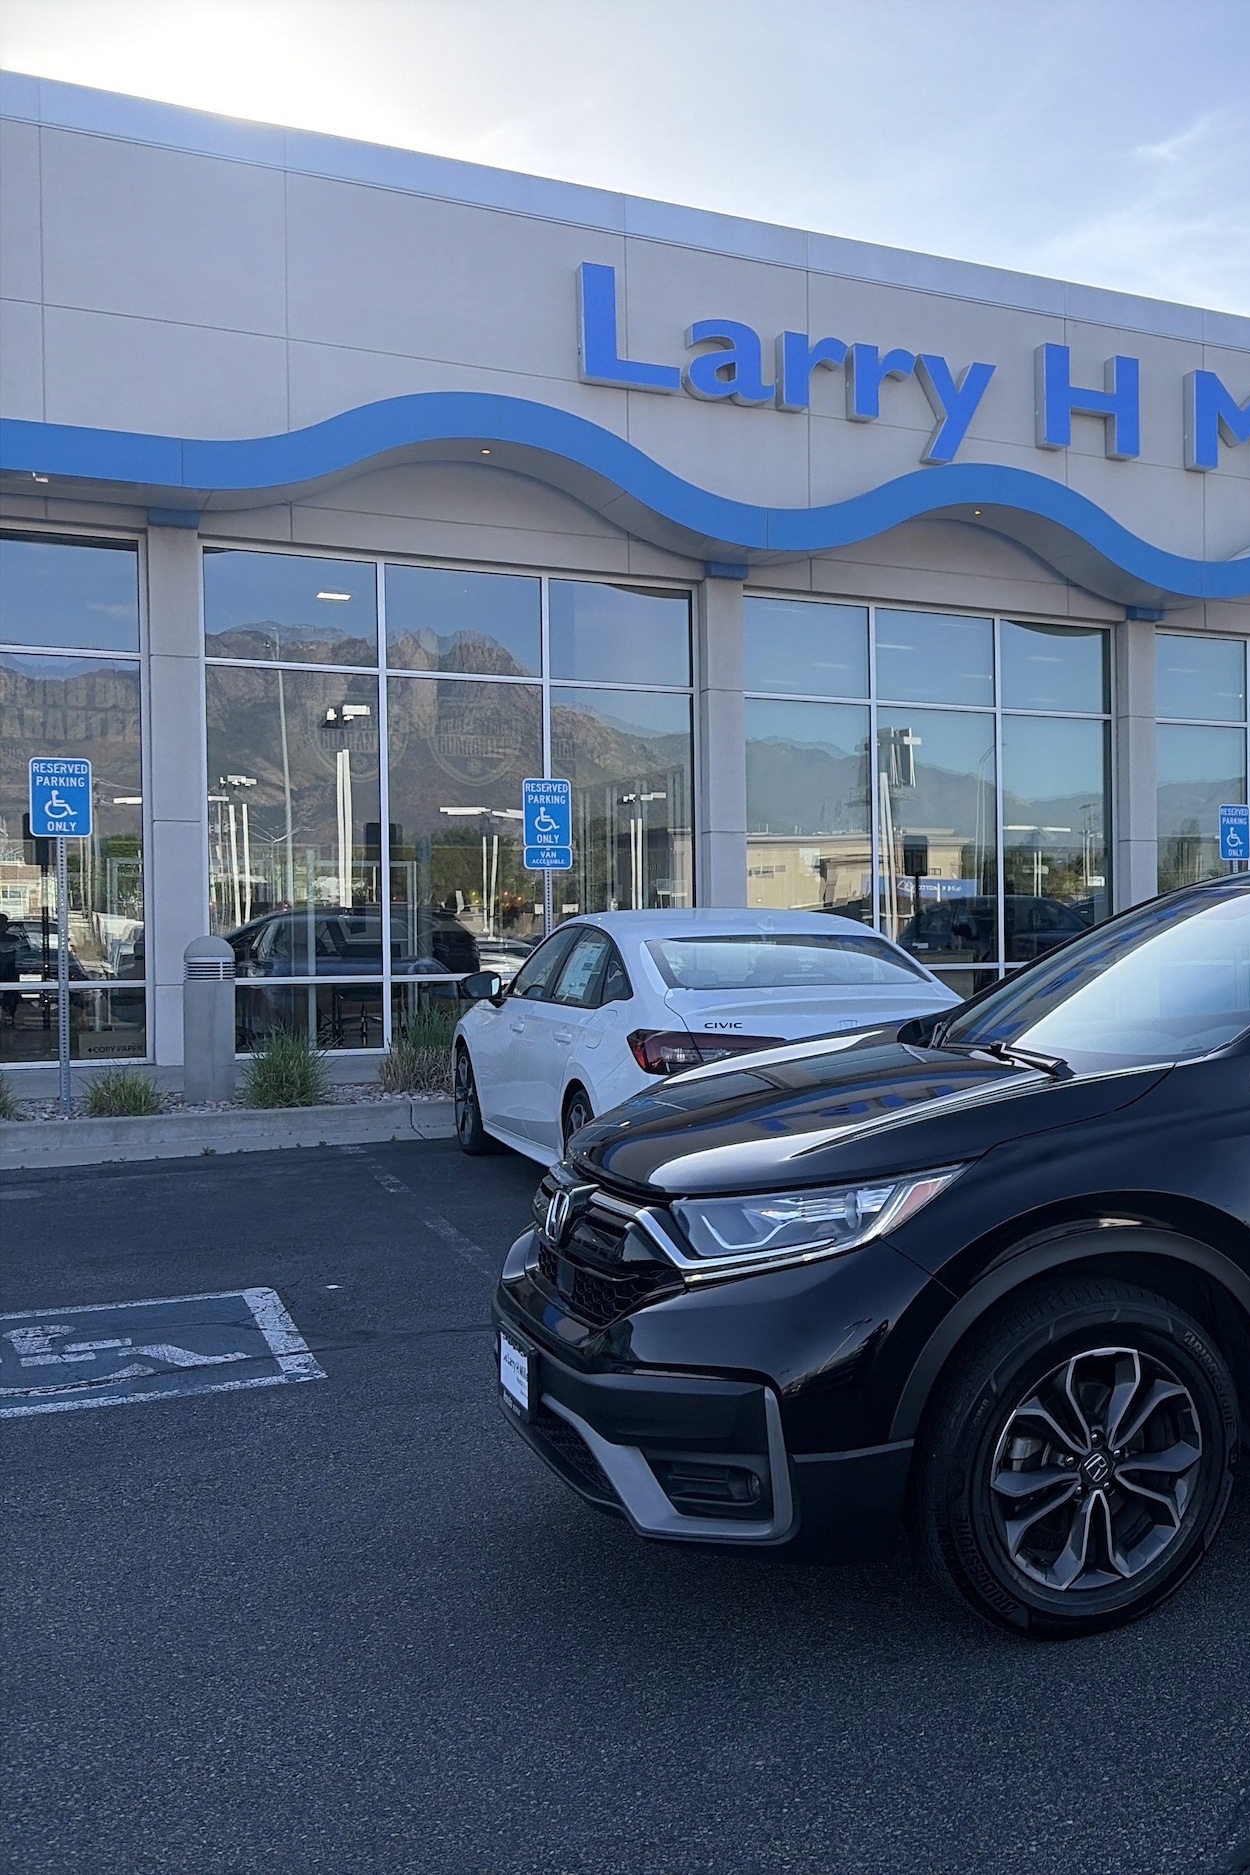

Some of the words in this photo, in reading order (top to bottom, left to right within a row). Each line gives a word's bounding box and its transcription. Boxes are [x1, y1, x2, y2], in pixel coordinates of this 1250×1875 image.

[576, 262, 997, 465] Larry
[1034, 342, 1140, 461] H
[32, 762, 88, 775] RESERVED
[36, 775, 85, 788] PARKING
[525, 783, 568, 793] RESERVED
[528, 794, 566, 805] PARKING
[1220, 808, 1249, 816] RESERVED
[47, 821, 77, 832] ONLY
[1222, 817, 1248, 826] PARKING
[536, 834, 560, 844] ONLY
[540, 851, 557, 859] VAN
[1227, 849, 1244, 857] ONLY
[531, 858, 565, 866] ACCESSIBLE
[93, 1046, 115, 1054] COPY
[117, 1045, 143, 1053] PAPER
